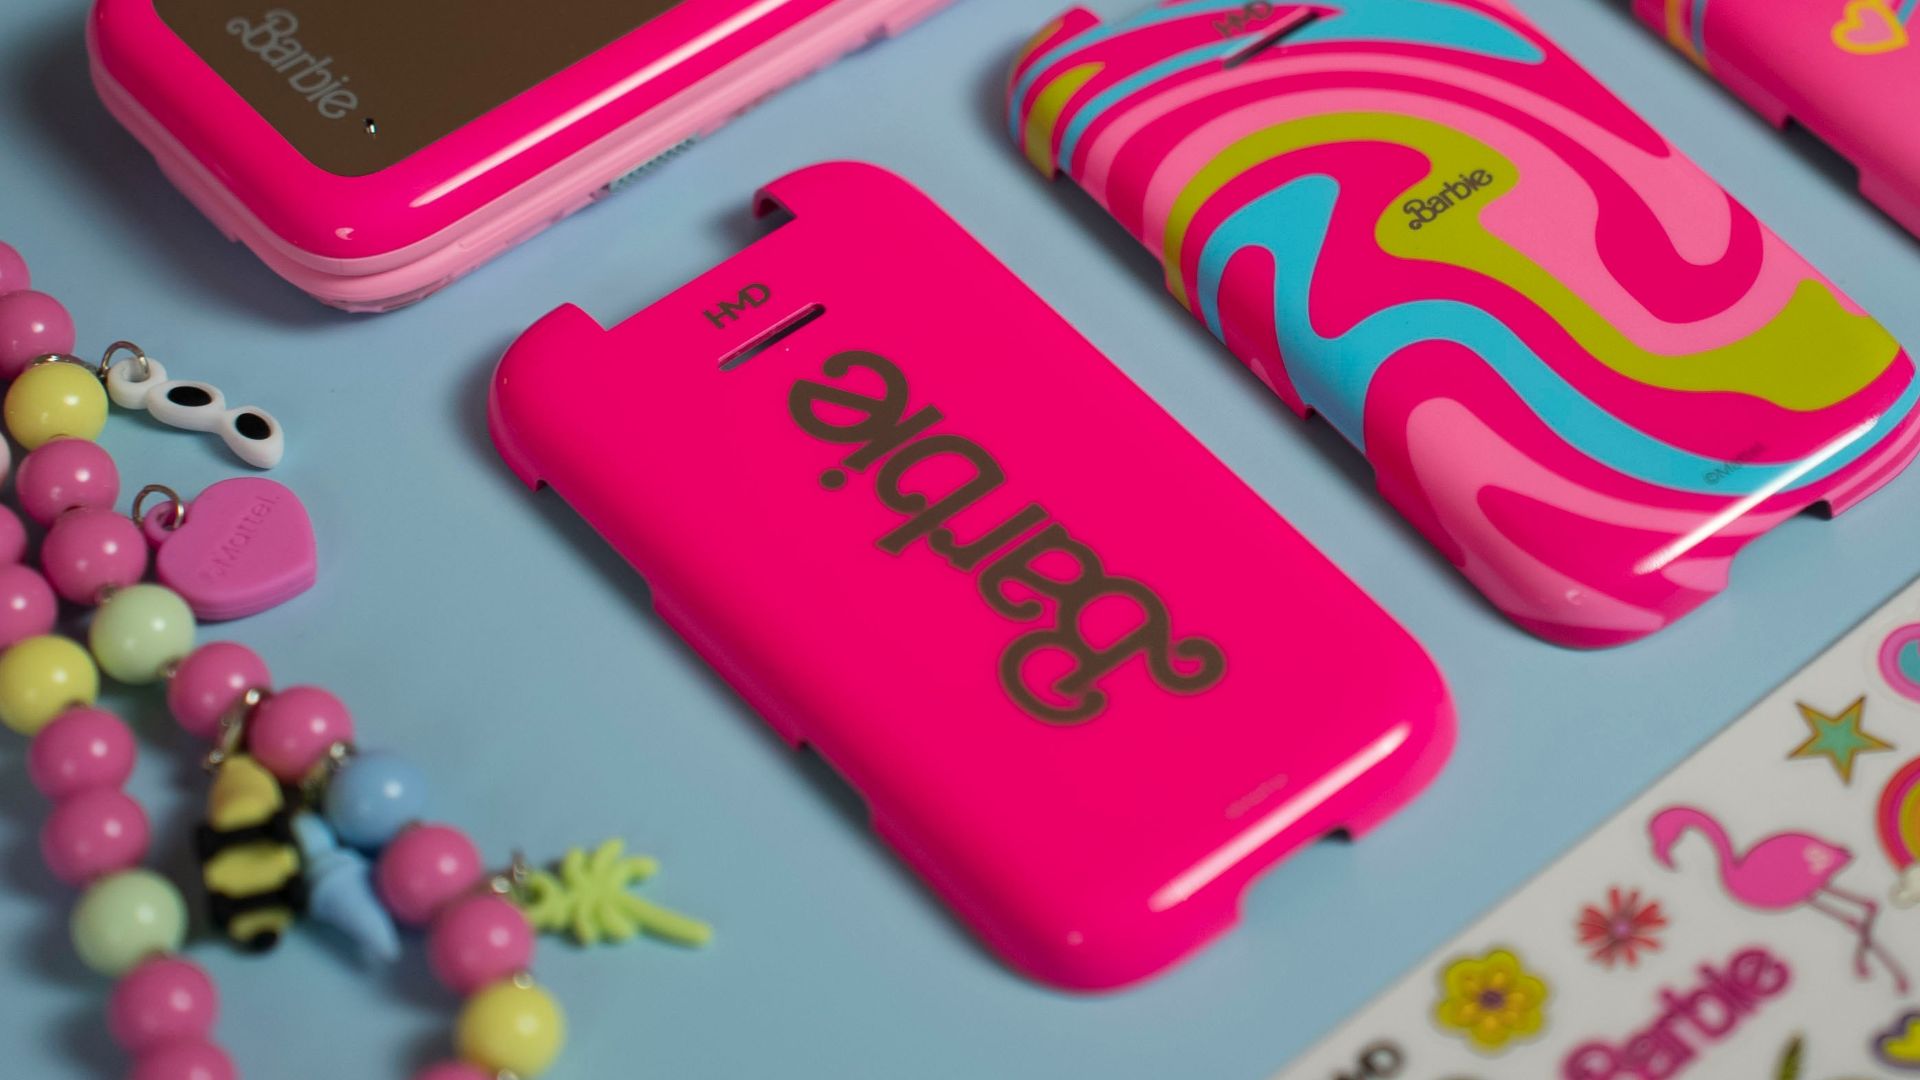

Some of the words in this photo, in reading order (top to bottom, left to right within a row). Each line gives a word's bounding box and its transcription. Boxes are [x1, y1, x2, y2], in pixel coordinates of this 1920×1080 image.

[226, 8, 358, 119] Barbie
[1402, 168, 1493, 231] Barbie
[703, 282, 770, 329] HMD
[788, 349, 1227, 727] Barbie
